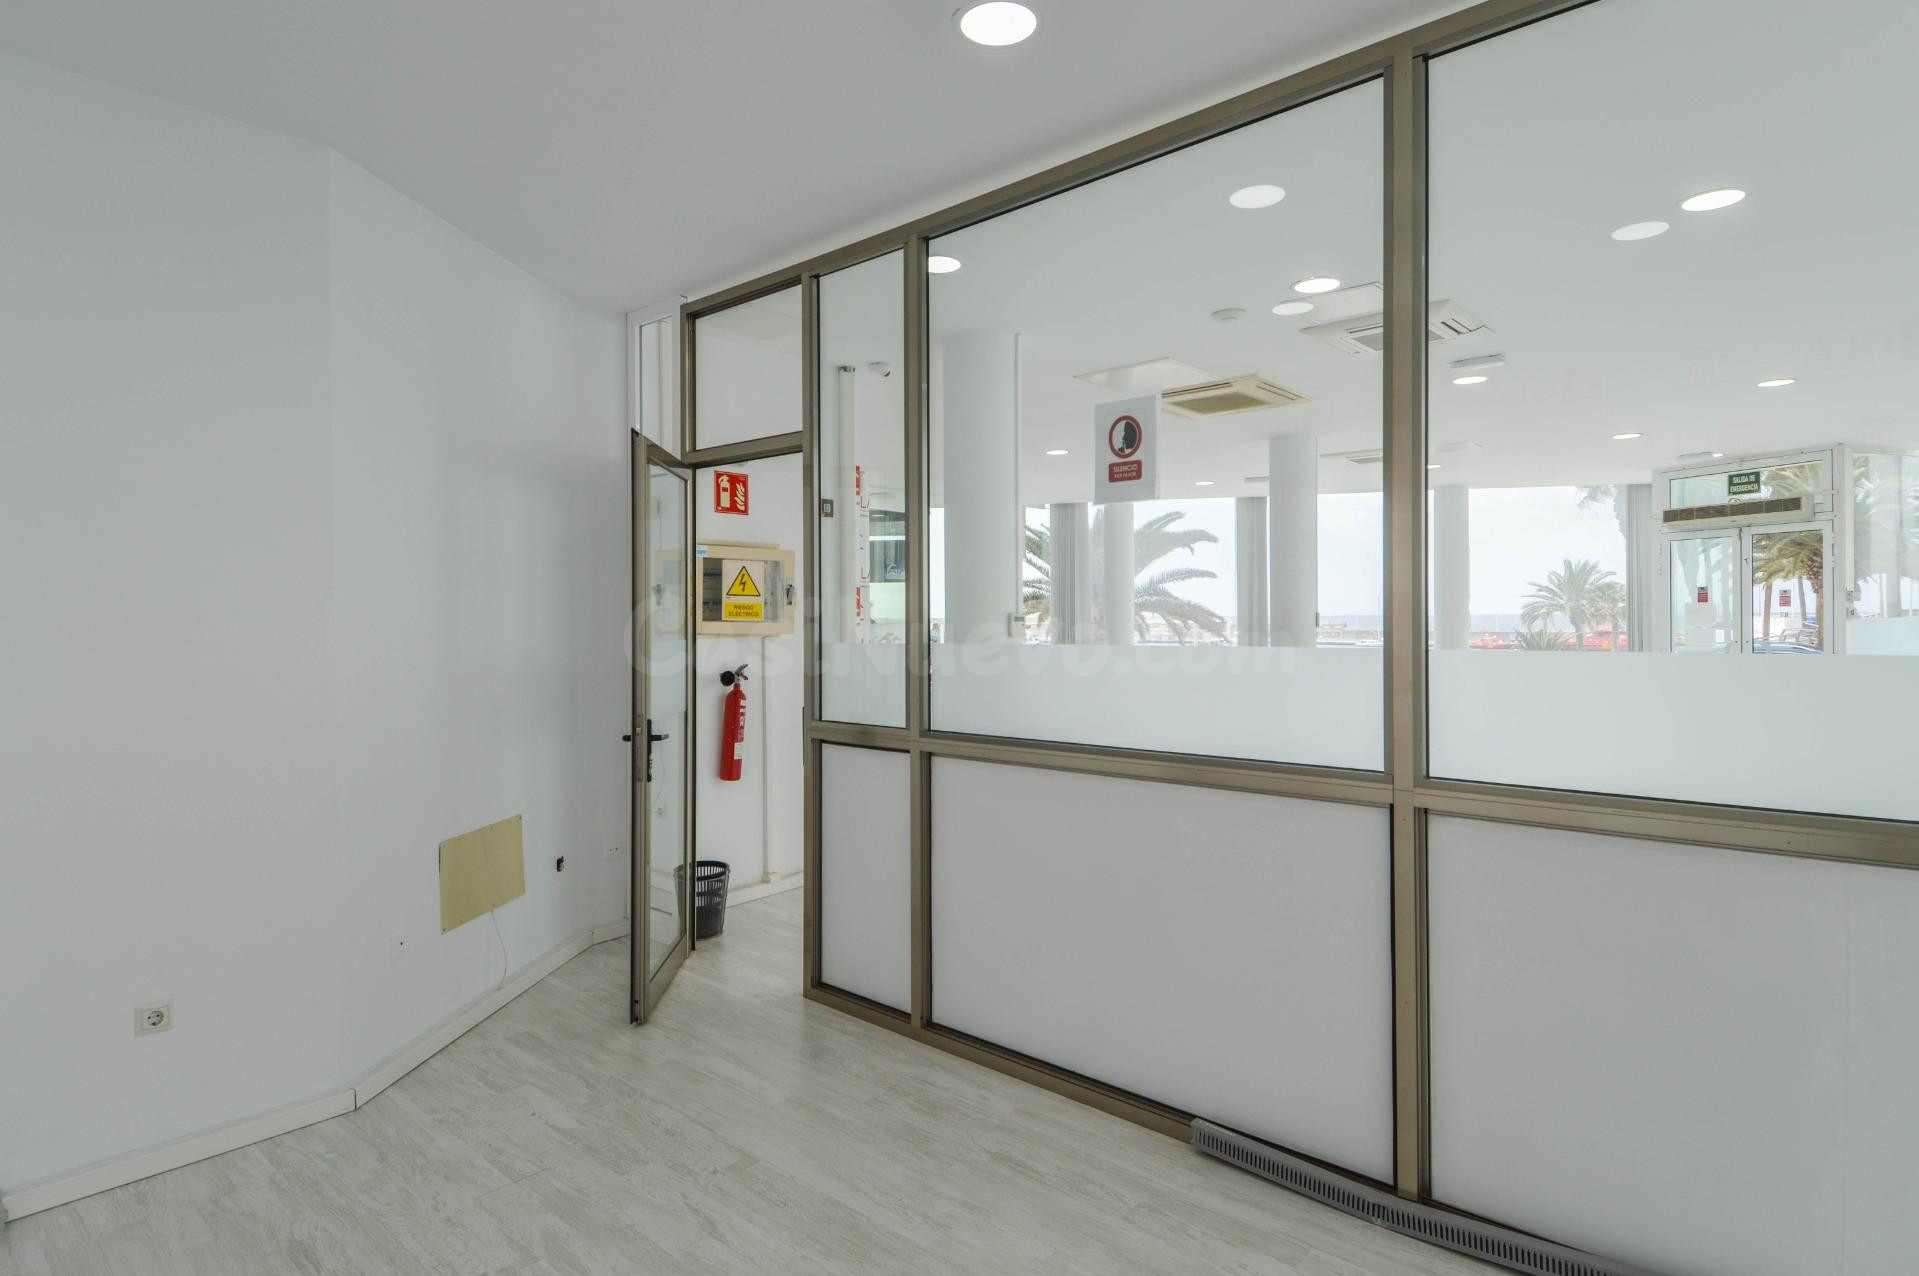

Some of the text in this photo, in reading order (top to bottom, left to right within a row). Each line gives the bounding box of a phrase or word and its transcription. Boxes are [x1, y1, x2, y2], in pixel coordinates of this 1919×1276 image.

[1113, 464, 1138, 473] SILENCIO
[1732, 474, 1756, 483] SALIDA DE
[1730, 483, 1759, 493] EMERGENCIA
